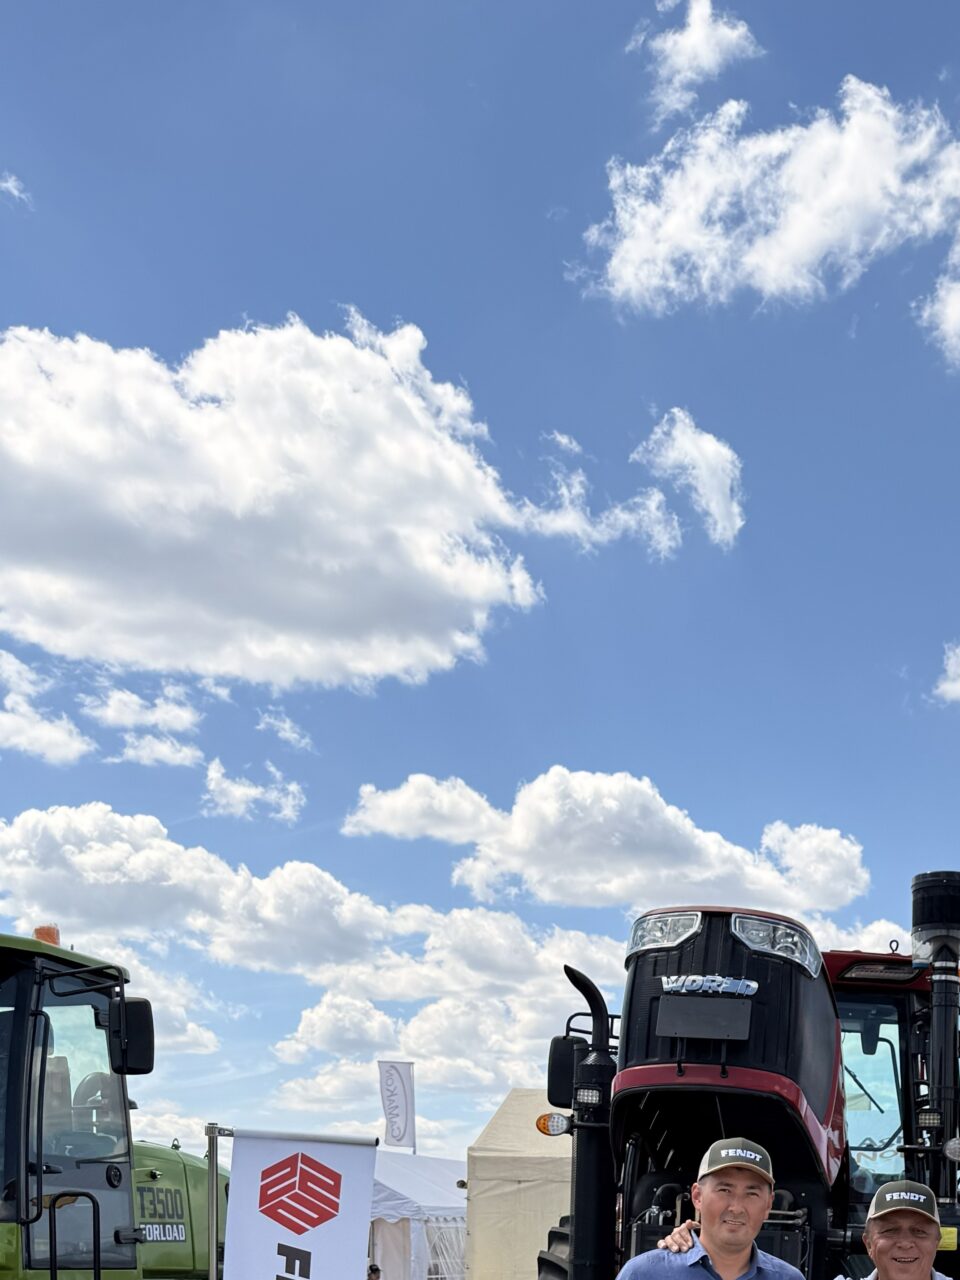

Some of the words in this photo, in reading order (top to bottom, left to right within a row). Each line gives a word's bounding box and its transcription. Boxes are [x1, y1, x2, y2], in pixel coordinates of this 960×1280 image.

[661, 974, 759, 996] WORLD
[720, 1148, 763, 1162] FENDT
[136, 1186, 184, 1220] T3500
[885, 1191, 927, 1203] FENDT
